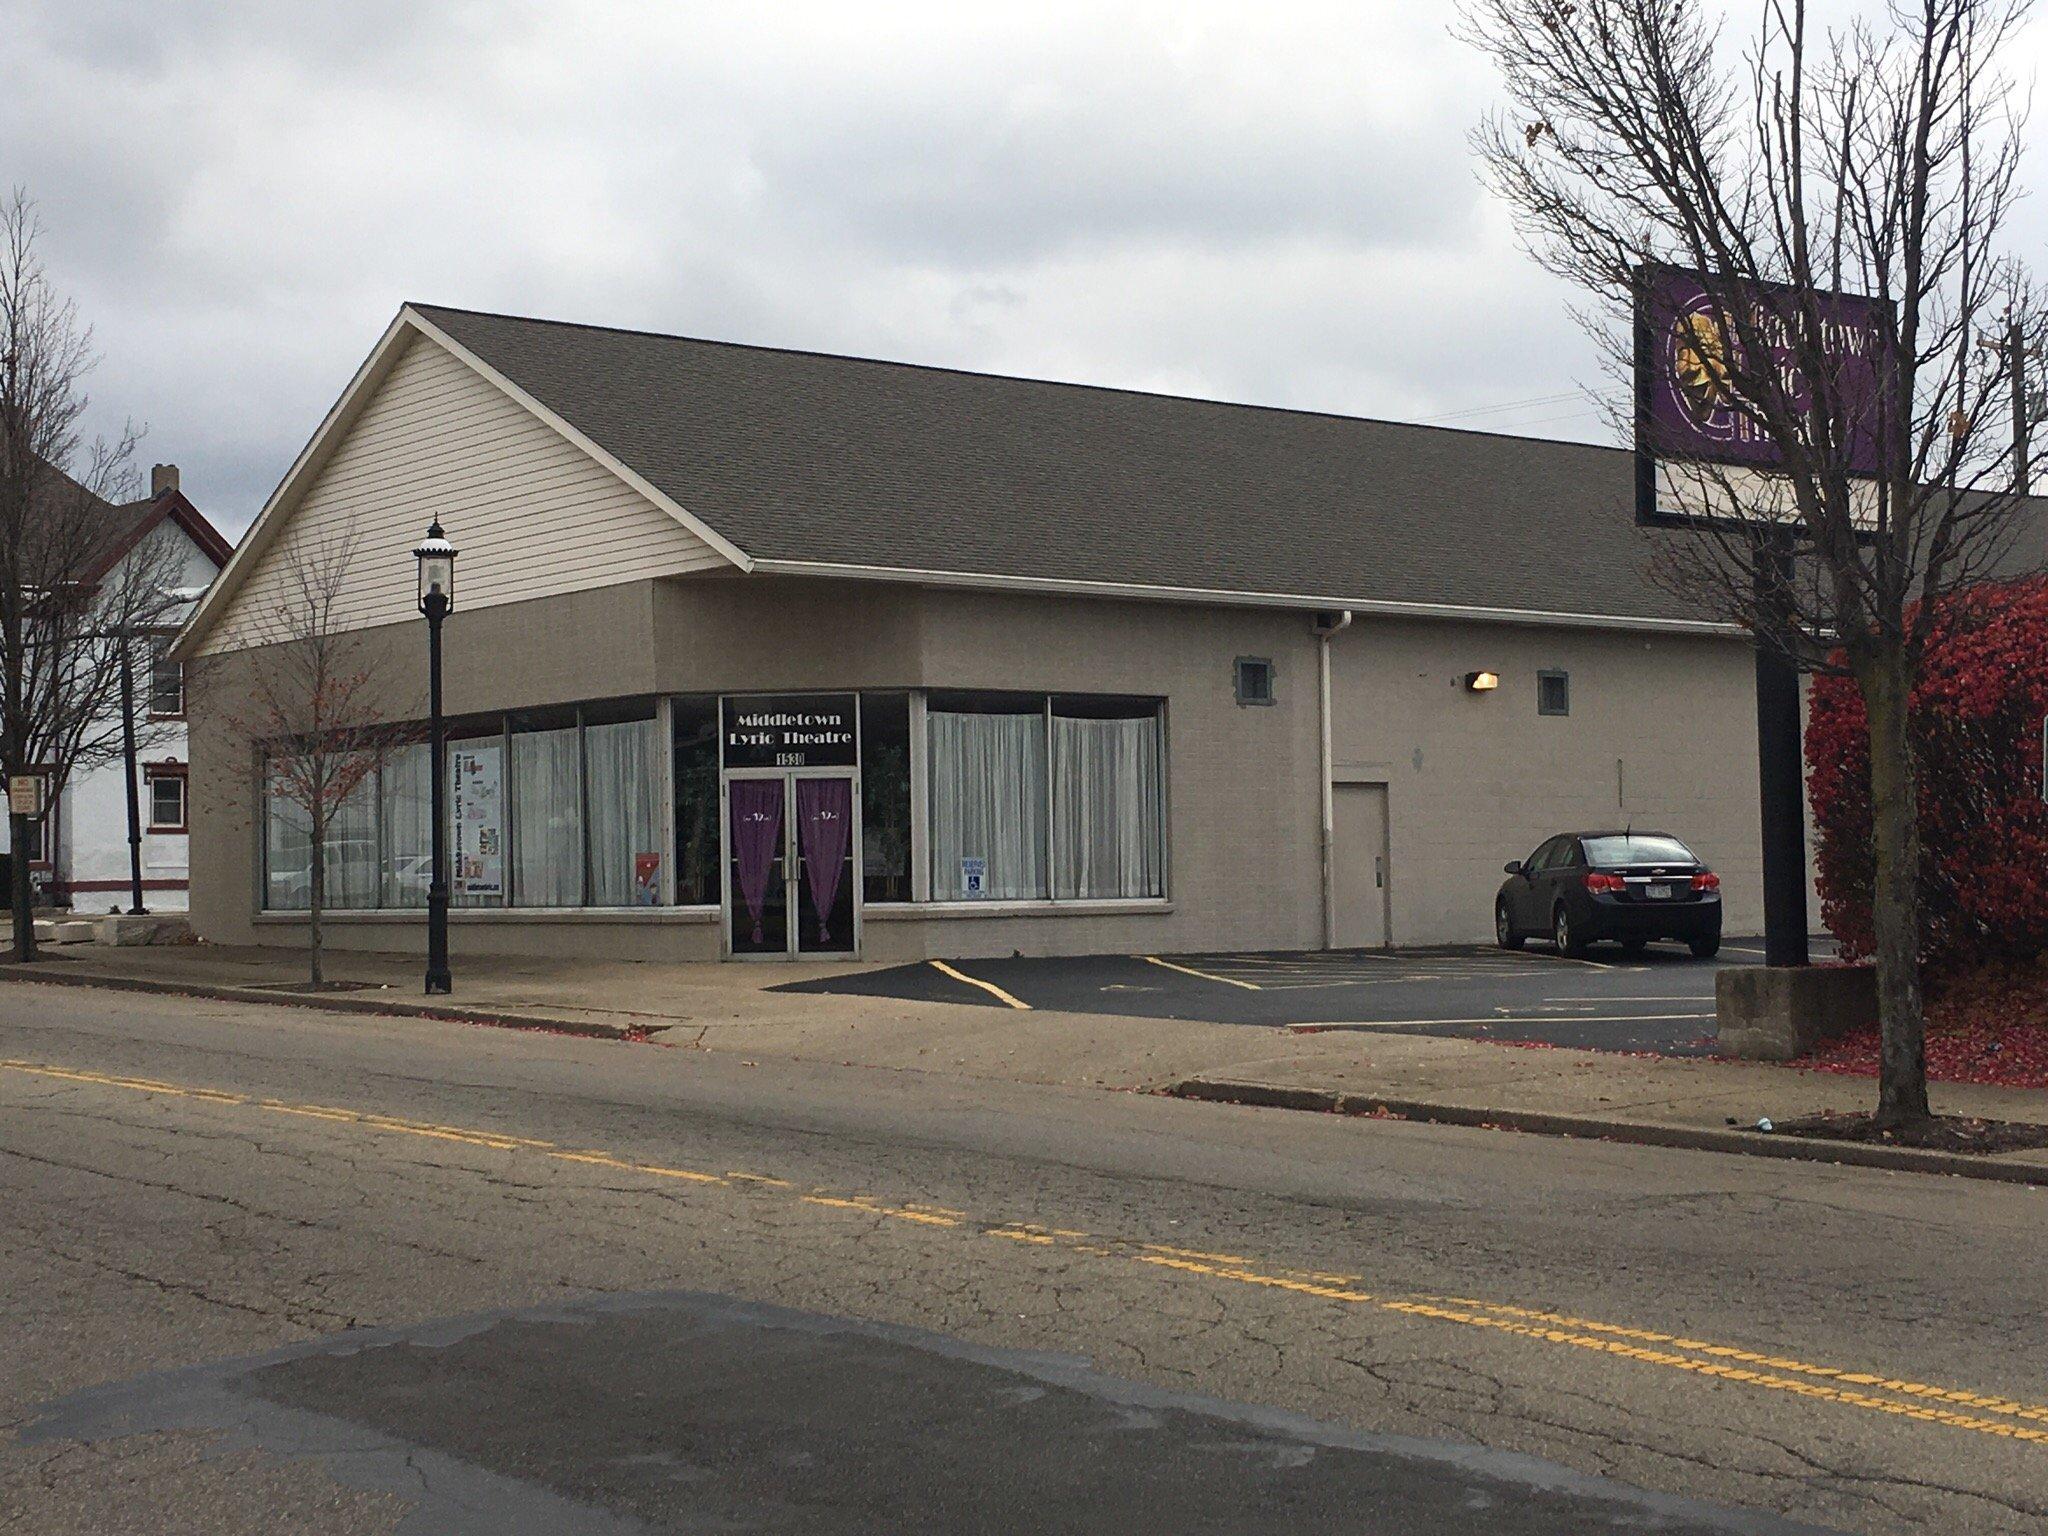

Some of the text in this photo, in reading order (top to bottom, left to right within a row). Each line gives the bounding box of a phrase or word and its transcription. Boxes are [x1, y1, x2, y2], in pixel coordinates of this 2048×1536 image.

[738, 713, 842, 727] Middletown
[729, 731, 852, 745] Lyric Theatre
[776, 752, 805, 765] 1530
